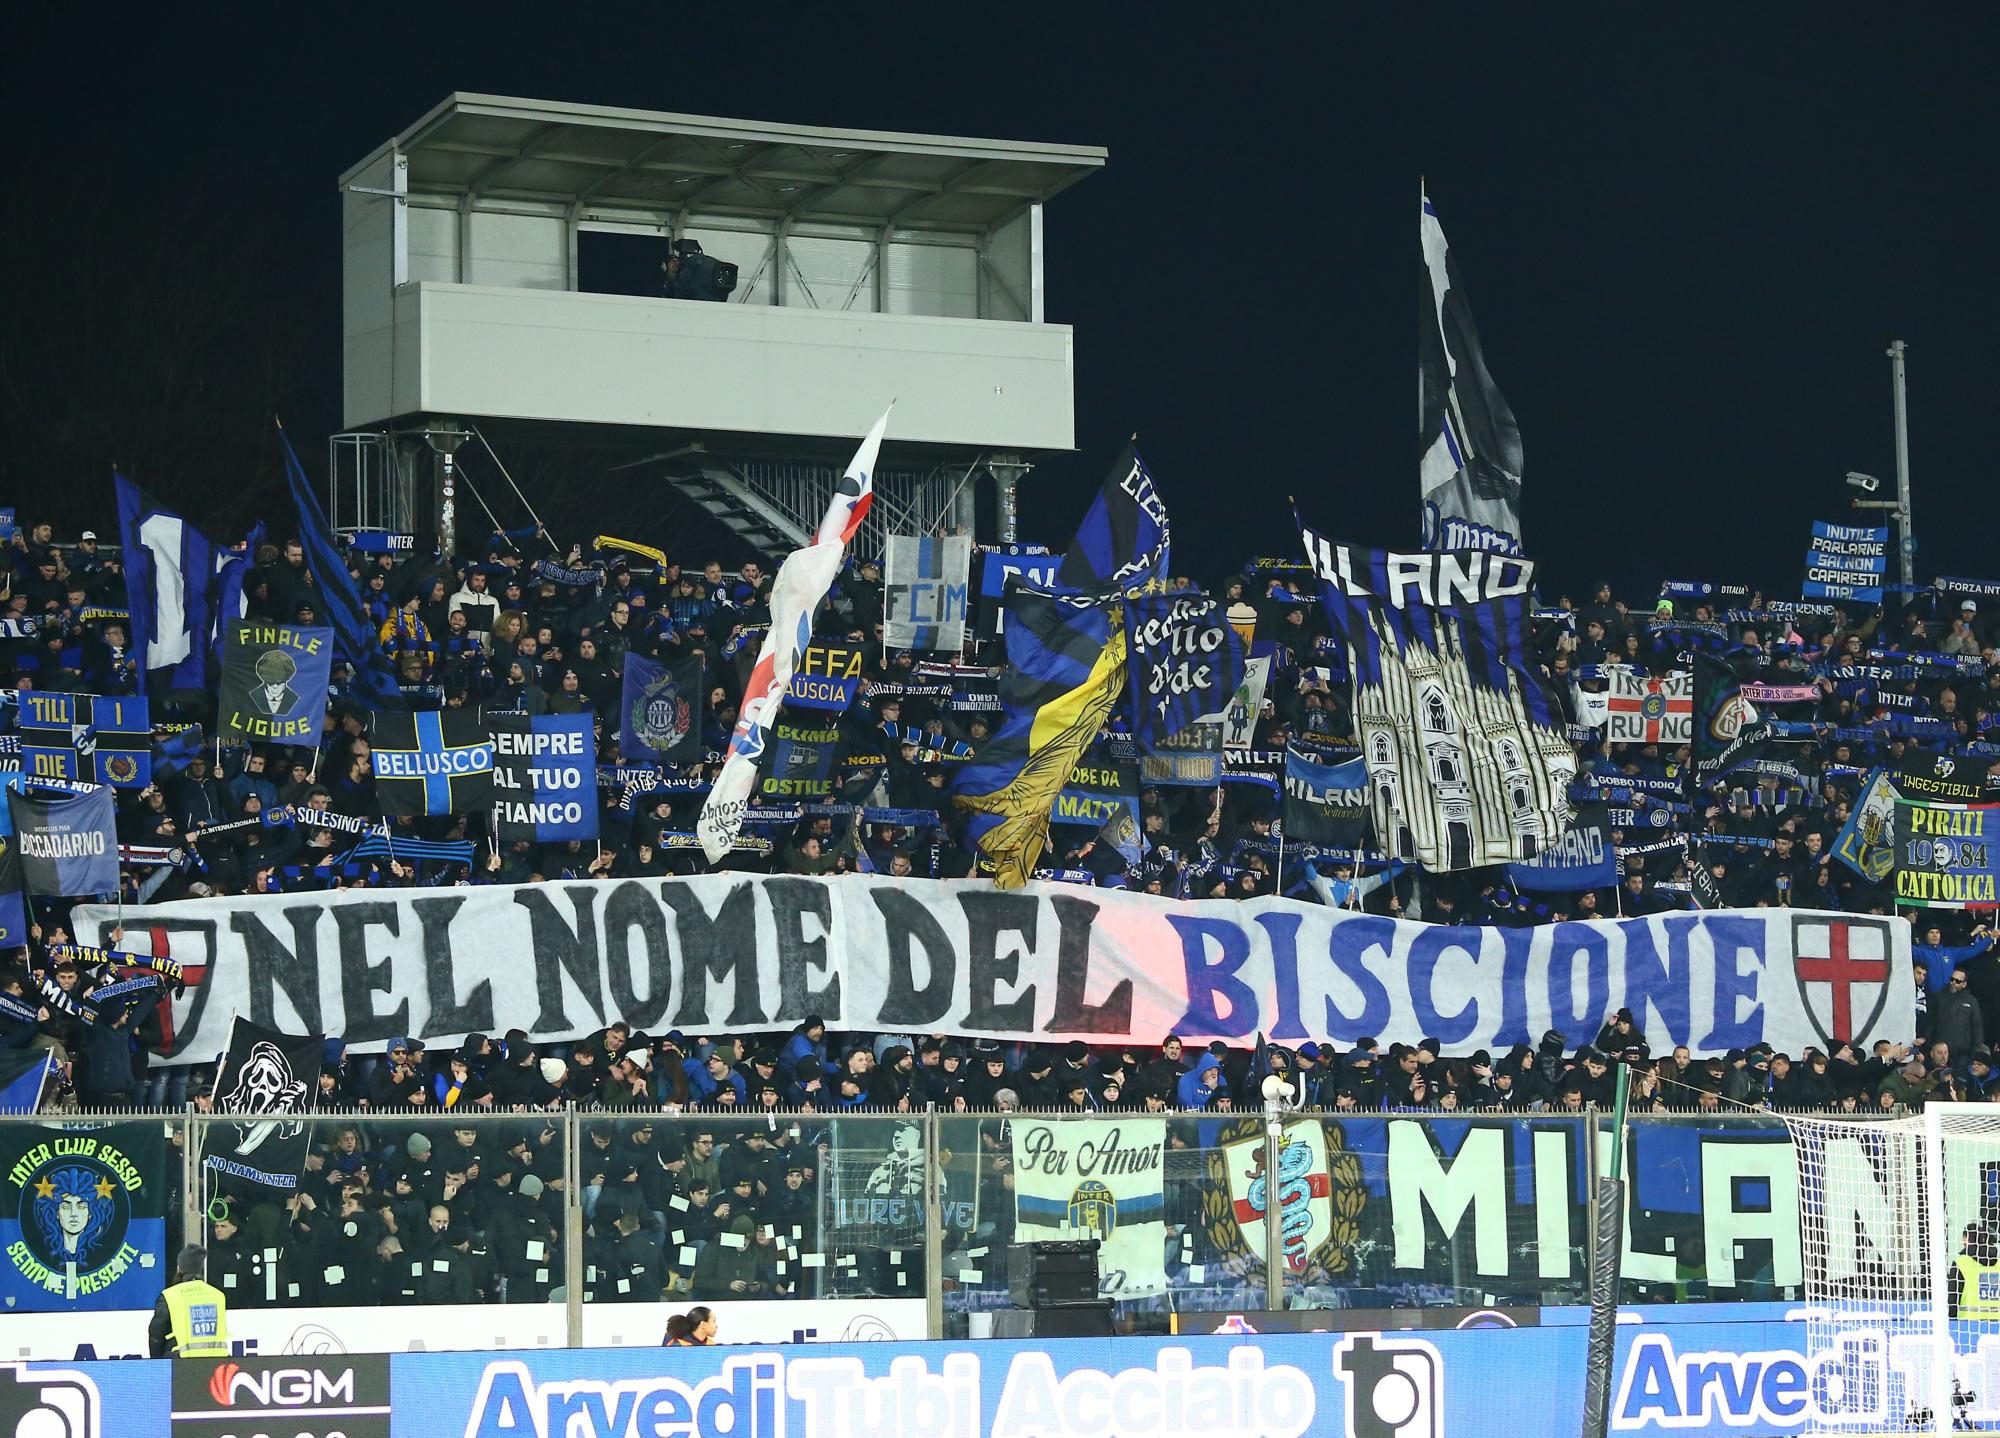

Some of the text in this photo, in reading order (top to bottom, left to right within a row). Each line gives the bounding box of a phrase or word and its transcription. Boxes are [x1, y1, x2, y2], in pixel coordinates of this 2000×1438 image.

[387, 535, 414, 550] INTER
[1827, 525, 1875, 540] INUTILE
[1812, 537, 1884, 556] PARLARNE
[1809, 568, 1880, 586] CAPIRESTI
[1949, 581, 2000, 595] FORZA INT
[887, 582, 967, 622] FCIM
[239, 627, 322, 655] FINALE
[1834, 665, 1893, 680] INTER
[784, 676, 846, 702] AÜSCIA
[1742, 686, 1761, 698] INTER
[1761, 687, 1781, 699] GIRLS
[1878, 691, 1913, 708] INTER
[115, 702, 122, 726] I
[230, 711, 311, 738] LIGURE
[777, 725, 840, 743] CLIMA
[35, 753, 68, 778] DIE
[377, 747, 488, 775] BELLUSCO
[493, 767, 580, 790] AL TUO
[617, 769, 655, 783] INTER
[763, 777, 831, 795] OSTILE
[1101, 770, 1121, 788] DA
[1598, 776, 1675, 790] GOBBO TI ODIO
[1904, 774, 1981, 798] INGESTIBILI
[297, 806, 361, 833] SOLESINO
[495, 800, 583, 824] FIANCO
[1911, 807, 1984, 836] PIRATI
[1960, 842, 1988, 869] 84
[1063, 869, 1084, 879] INTER
[1897, 870, 1996, 901] CATTOLICA
[62, 945, 184, 980] ULTRAS INTER
[231, 877, 1767, 1055] NEL NOME DEL BISCIONE
[1018, 1126, 1069, 1177] Per
[8, 1138, 143, 1192] INTER CLUB SESSO
[208, 1154, 296, 1188] NO NAME INTER
[1077, 1192, 1109, 1201] INTER
[916, 1202, 974, 1229] VVE
[75, 1241, 139, 1295] PRESETI
[228, 1368, 353, 1406] NGM
[1622, 1340, 1880, 1417] Arvedi
[475, 1353, 1309, 1438] Arvedi Tubi Acciaio
